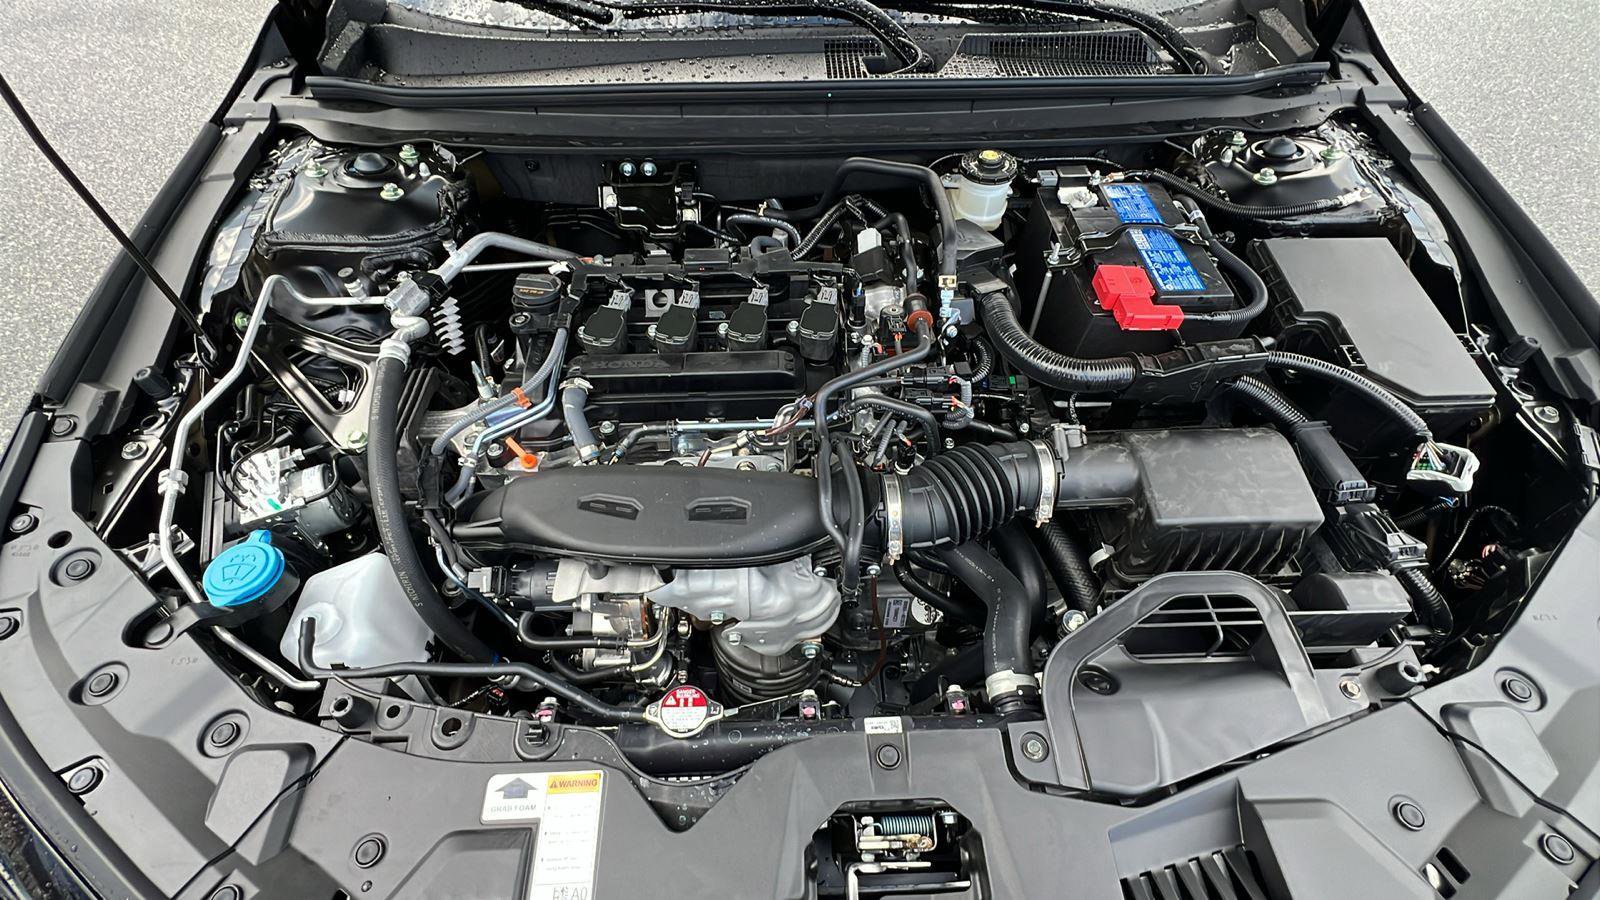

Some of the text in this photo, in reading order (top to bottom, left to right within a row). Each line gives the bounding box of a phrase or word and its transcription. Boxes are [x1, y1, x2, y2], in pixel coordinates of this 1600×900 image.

[591, 359, 670, 369] HONDA
[398, 571, 420, 601] NICHIRIN
[559, 778, 598, 788] WARNING
[513, 803, 537, 812] FOAM
